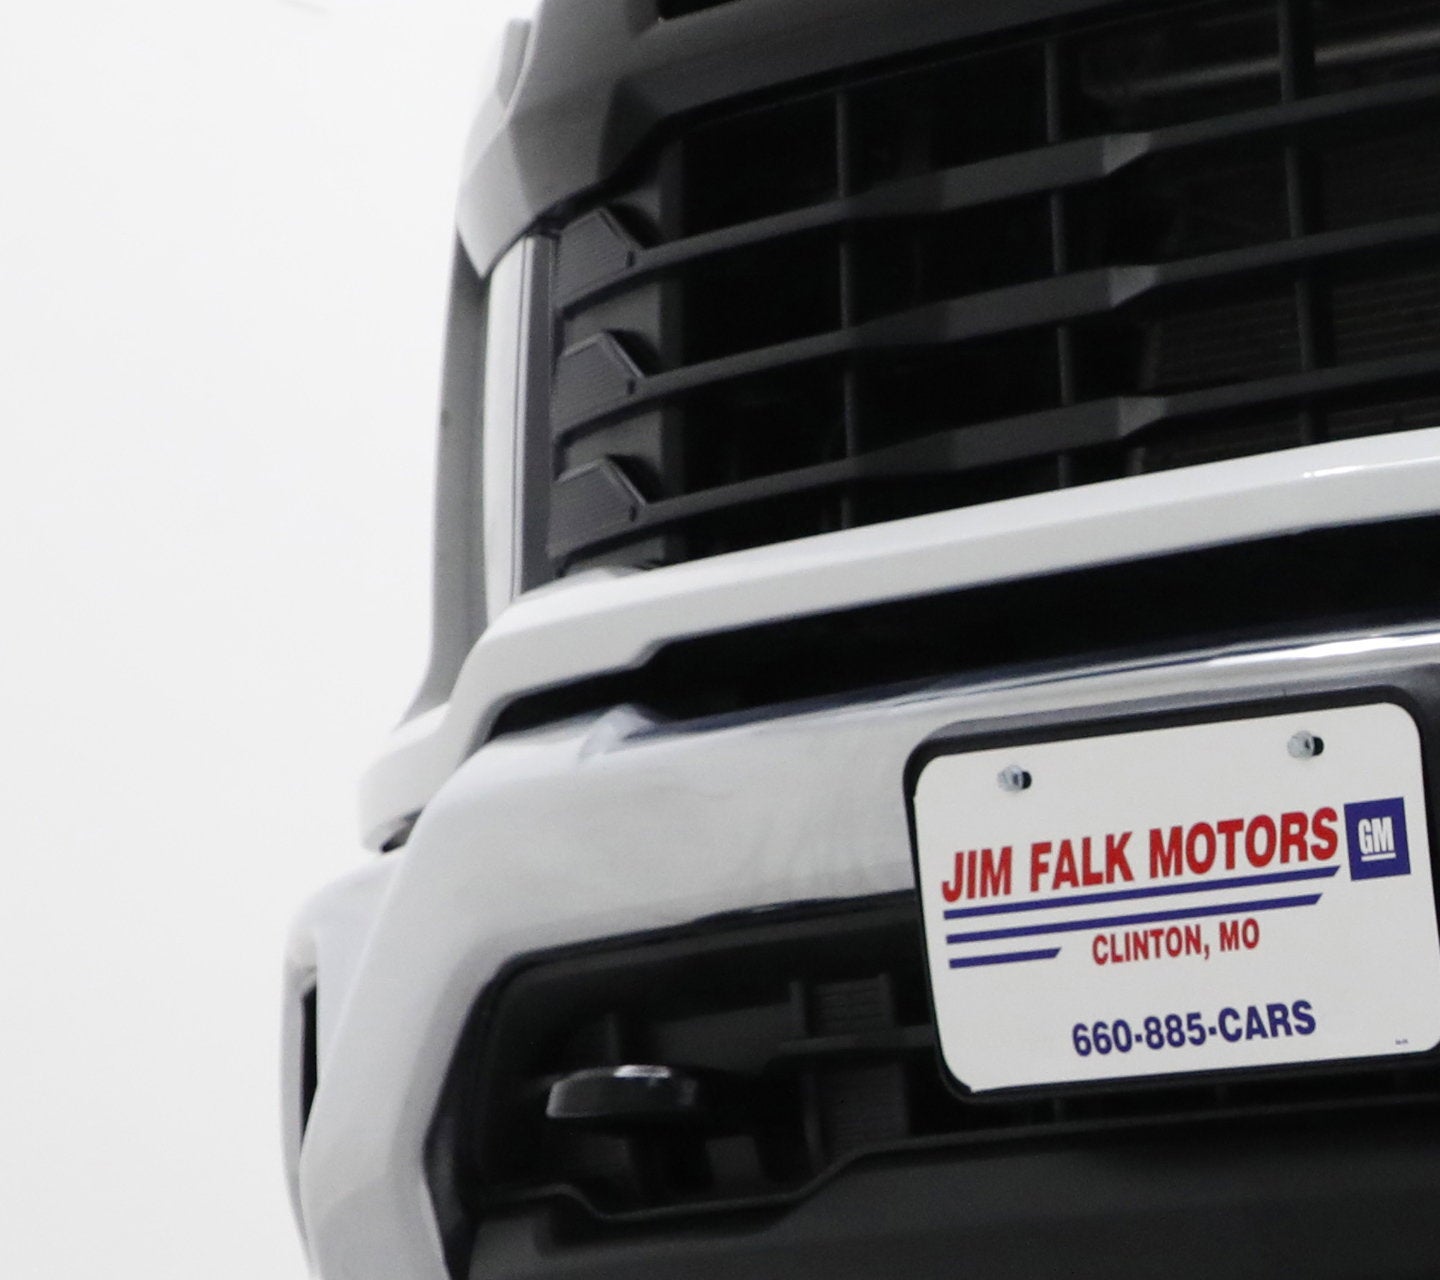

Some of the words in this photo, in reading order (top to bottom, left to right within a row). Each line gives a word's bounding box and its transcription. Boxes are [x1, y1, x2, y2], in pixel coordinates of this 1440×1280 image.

[941, 846, 1014, 904] JIM
[1030, 832, 1135, 893] FALK
[1148, 806, 1339, 879] MOTORS
[1358, 815, 1395, 855] GM
[1092, 926, 1211, 966] CLINTON,
[1219, 917, 1260, 952] MO
[1072, 1000, 1317, 1057] 660-885-CARS
